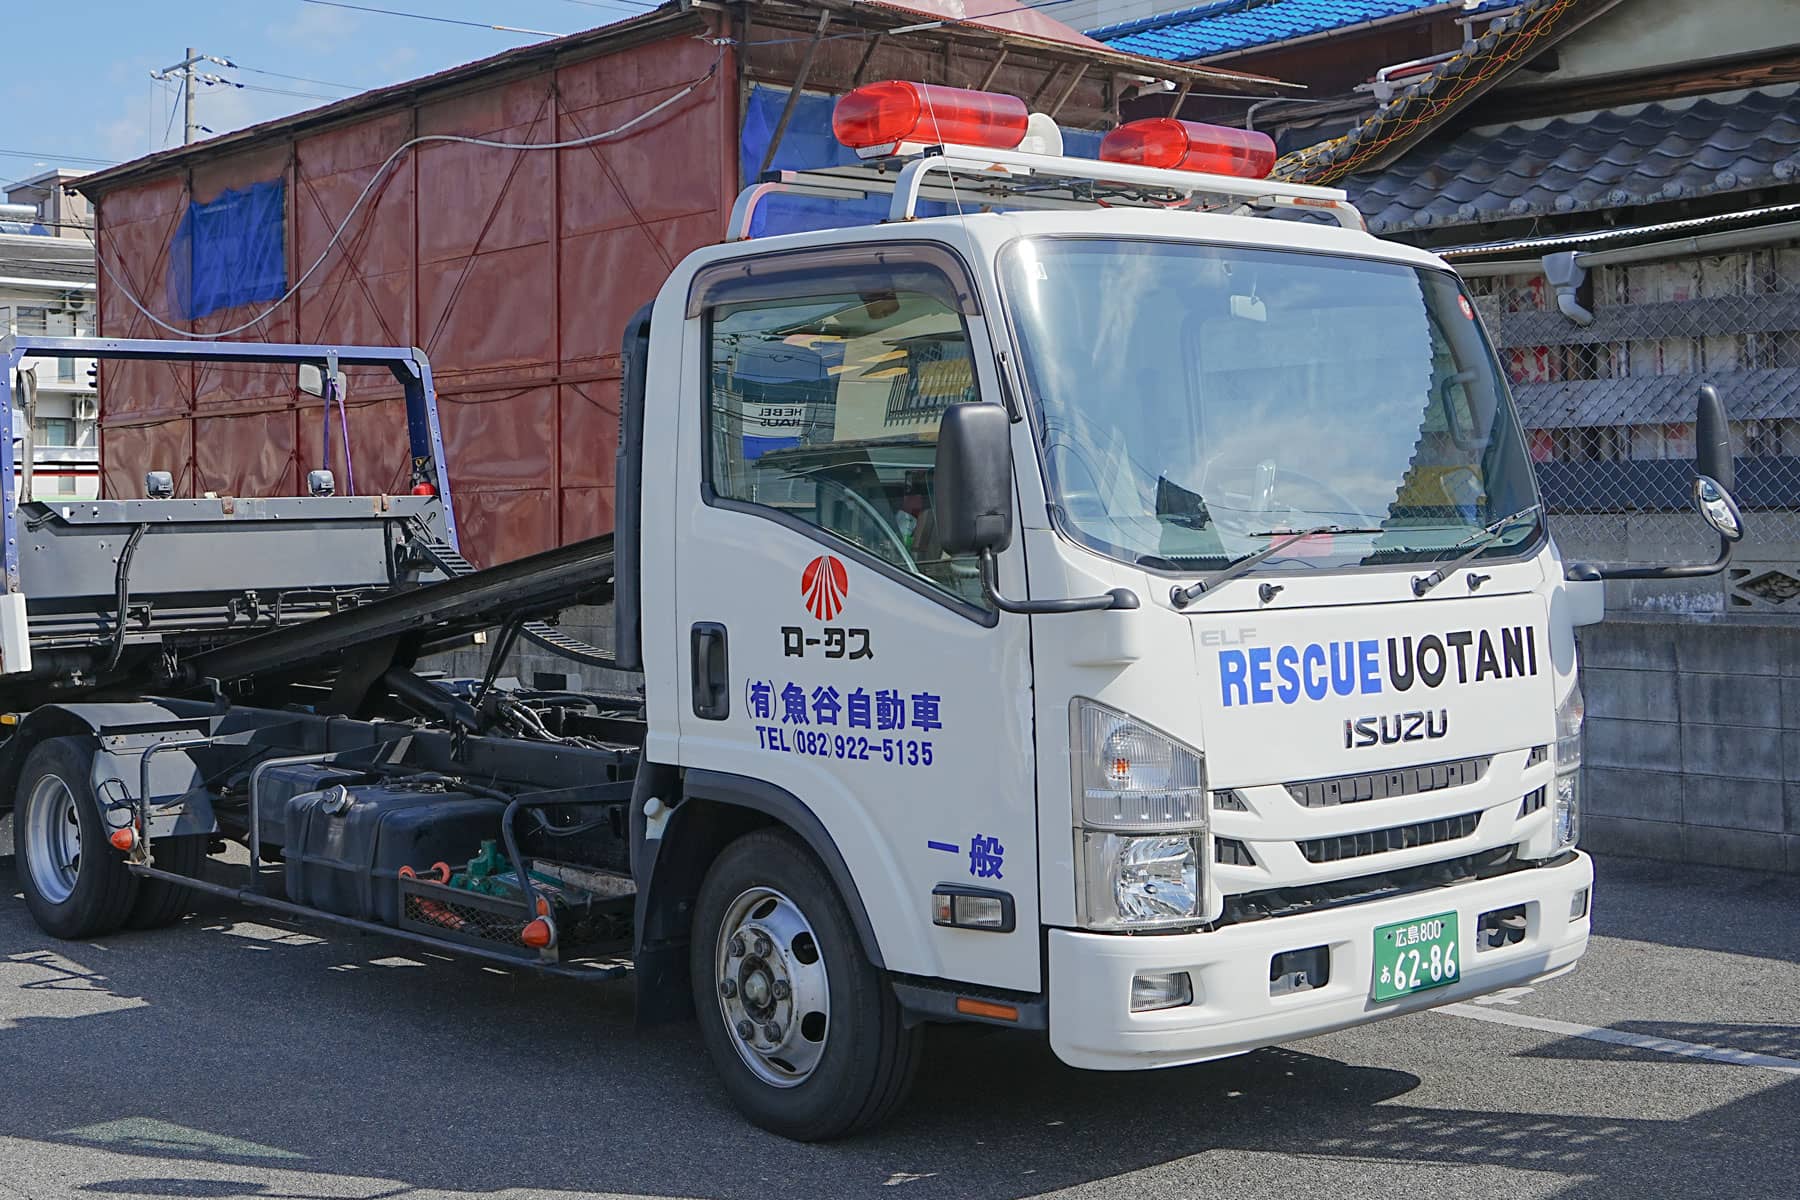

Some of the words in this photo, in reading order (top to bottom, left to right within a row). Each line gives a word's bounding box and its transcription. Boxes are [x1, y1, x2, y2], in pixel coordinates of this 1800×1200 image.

[780, 626, 874, 660] ロータス
[1201, 627, 1256, 647] ELF
[745, 678, 943, 732] (有)魚谷自動車
[1343, 708, 1448, 749] ISUZU
[927, 833, 1004, 880] 一般
